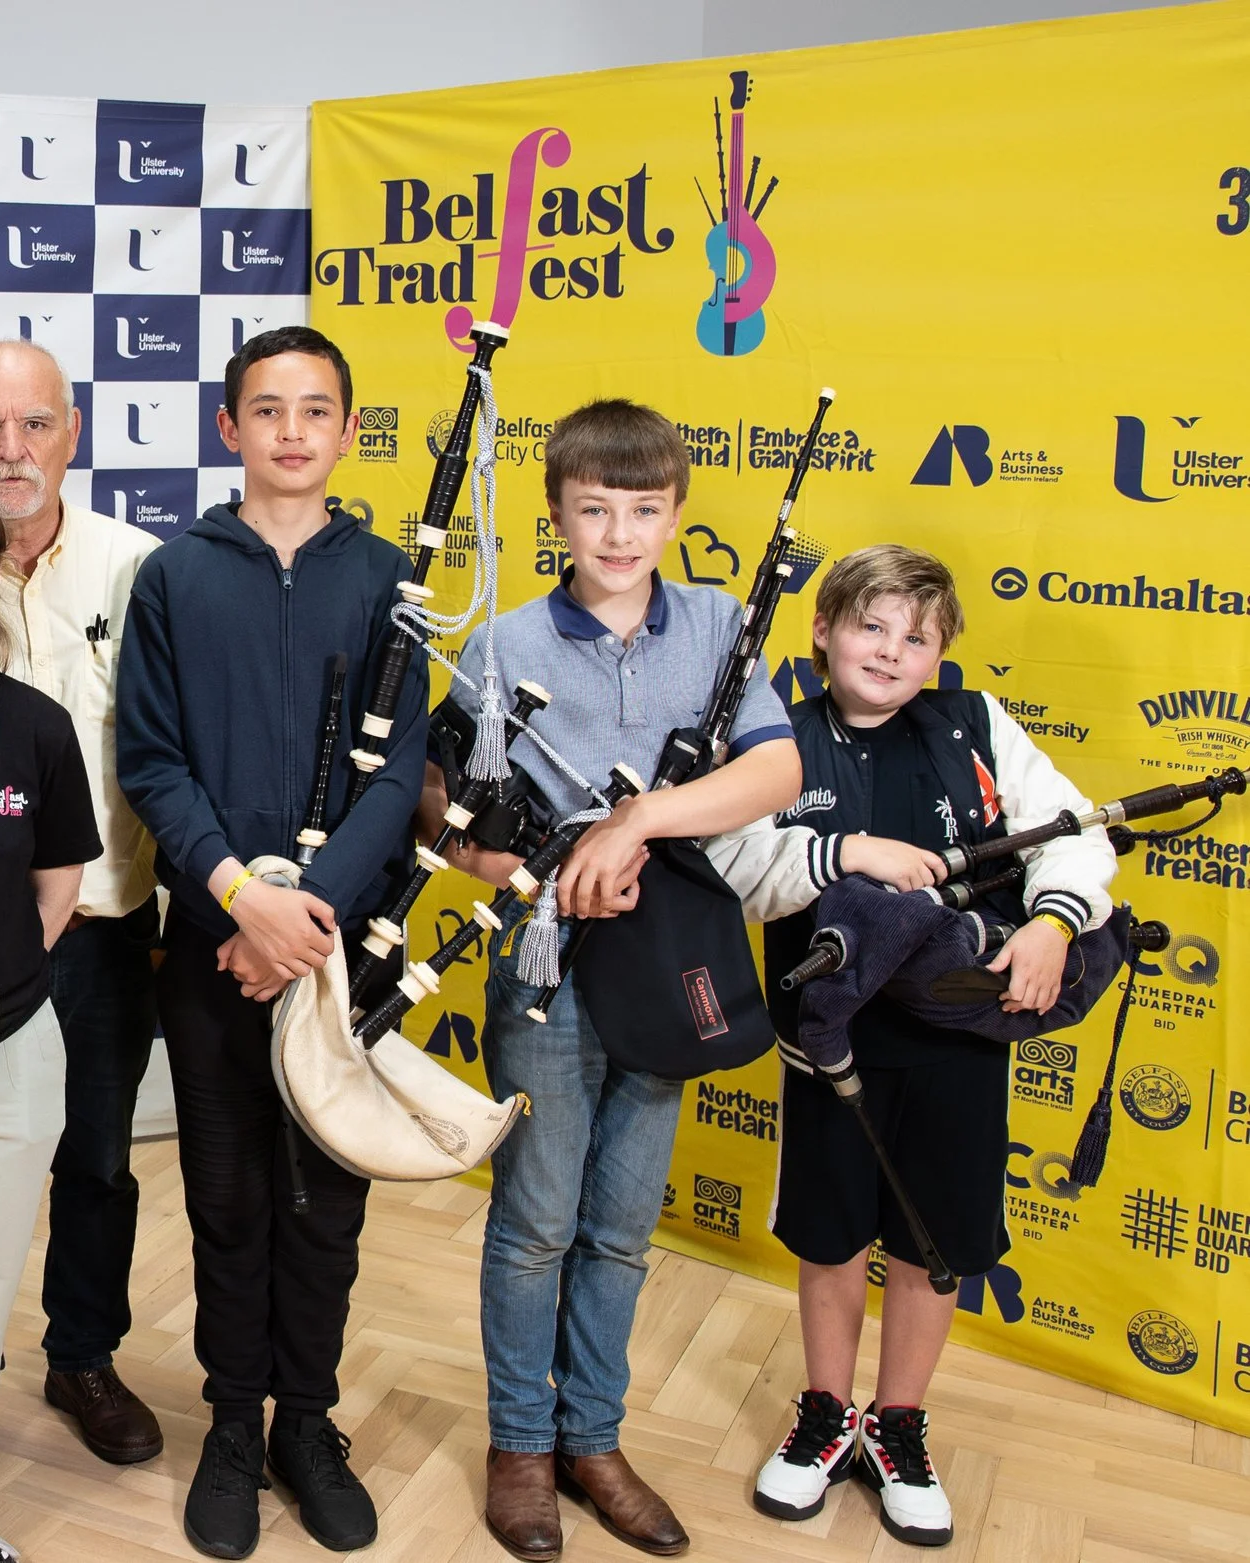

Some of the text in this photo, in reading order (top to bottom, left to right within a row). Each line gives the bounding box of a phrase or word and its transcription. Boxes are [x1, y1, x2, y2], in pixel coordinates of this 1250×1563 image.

[141, 157, 166, 167] Ulster
[141, 166, 184, 177] University
[379, 127, 674, 255] Belfast
[32, 243, 59, 252] Ulster
[32, 251, 76, 263] University
[243, 247, 268, 256] Ulster
[243, 255, 284, 265] University
[139, 333, 165, 342] Ulster
[139, 342, 181, 352] University
[495, 418, 557, 438] Belfas
[359, 431, 397, 447] arts
[750, 426, 859, 450] Embrce a
[359, 447, 397, 458] council
[494, 441, 527, 466] City
[811, 448, 877, 472] Spirit
[1001, 450, 1048, 464] Arts &
[1174, 451, 1243, 469] Ulster
[1000, 462, 1063, 475] Business
[1173, 469, 1250, 488] Univer
[137, 506, 162, 514] Ulster
[137, 513, 178, 523] University
[445, 553, 466, 568] BID
[1038, 571, 1250, 616] Comhalta
[1177, 731, 1250, 749] IRISH WHISKEY
[1140, 759, 1161, 767] THE
[1167, 762, 1206, 773] SPIRIT
[1145, 851, 1250, 890] Irelan
[1129, 995, 1205, 1019] QUARTER
[1154, 1018, 1176, 1031] BID
[1015, 1067, 1074, 1093] arts
[1124, 1067, 1190, 1102] BELFAST
[1014, 1085, 1073, 1106] council
[697, 1101, 779, 1142] Irelan
[1141, 1107, 1188, 1128] COUNCIL
[693, 1201, 740, 1227] arts
[1007, 1195, 1080, 1223] THEDRAL
[693, 1217, 740, 1237] council
[1009, 1207, 1069, 1231] UARTER
[1023, 1228, 1043, 1240] BID
[1194, 1247, 1230, 1274] BID
[1033, 1296, 1079, 1318] Arts &
[1031, 1319, 1090, 1341] Northern Ireland
[1032, 1306, 1095, 1335] Business
[1131, 1312, 1196, 1353] BELFAST
[1149, 1356, 1195, 1373] COUNCIL
